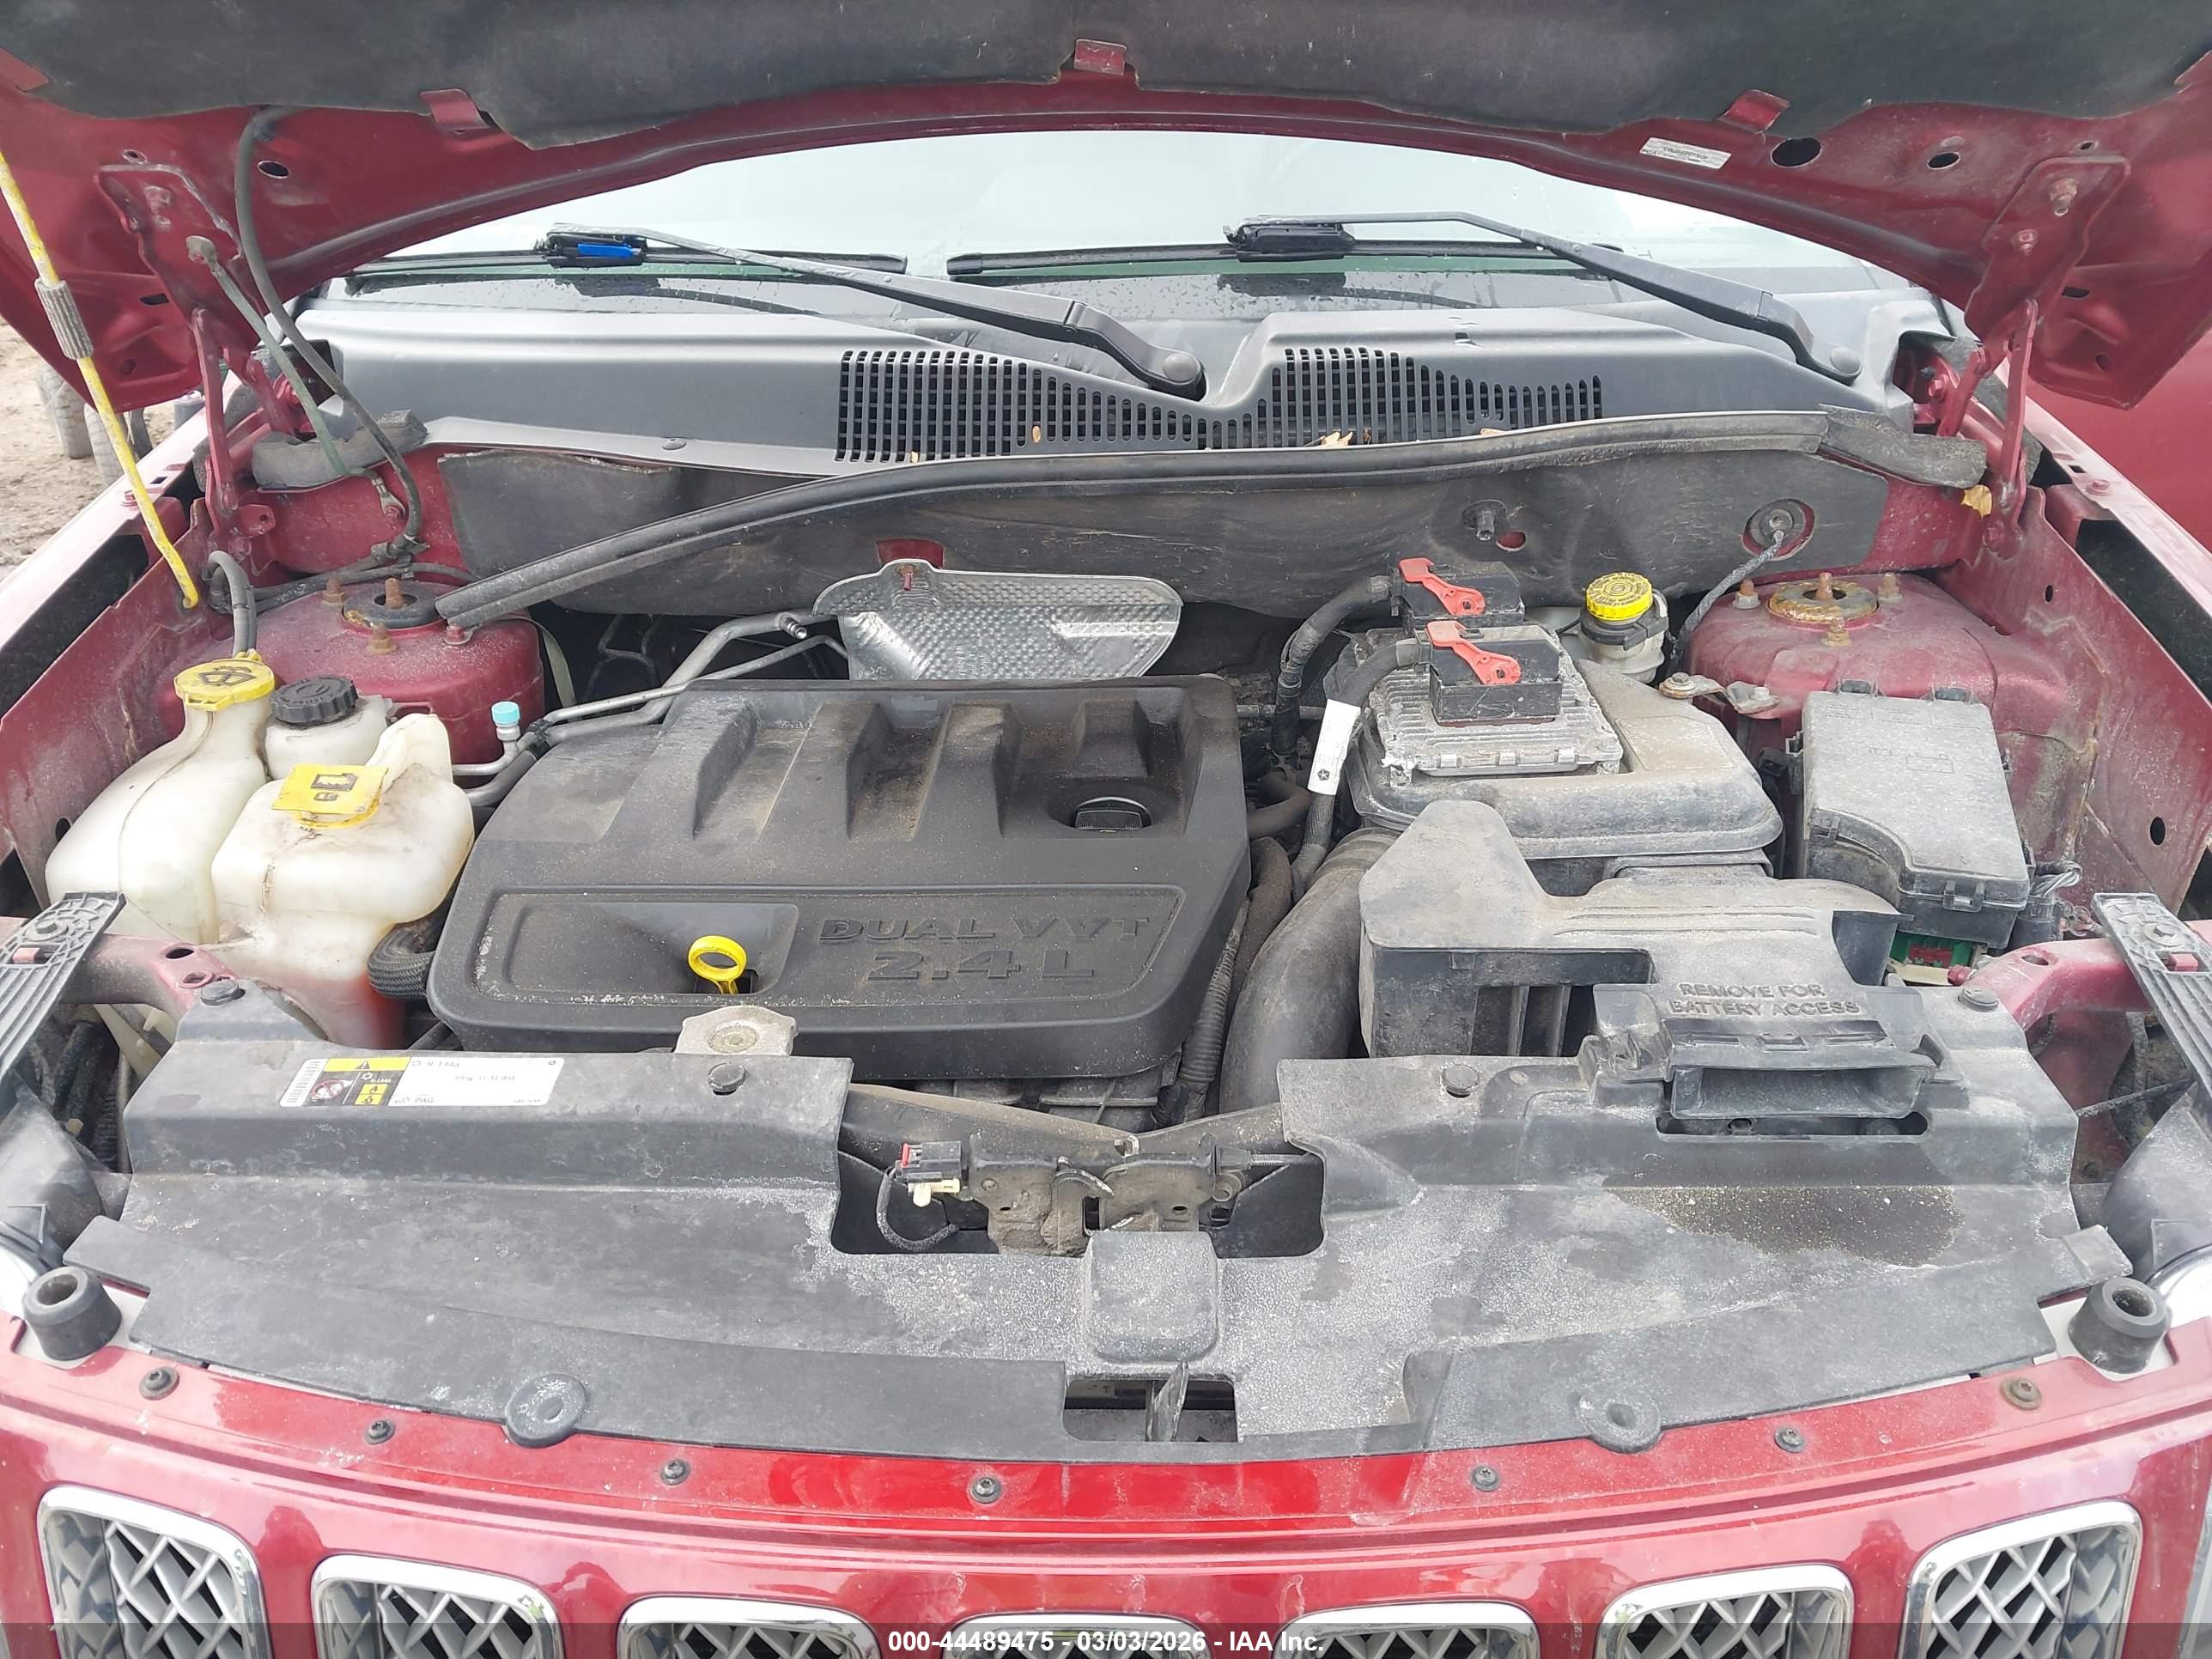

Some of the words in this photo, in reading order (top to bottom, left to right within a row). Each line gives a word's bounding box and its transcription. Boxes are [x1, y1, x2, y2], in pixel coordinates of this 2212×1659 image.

[819, 919, 995, 941] DUAL
[1011, 916, 1149, 940] VVT
[1678, 983, 1774, 998] REMOVE
[1777, 983, 1826, 998] FOR
[1669, 1000, 1762, 1016] BATTERY
[1772, 1000, 1861, 1016] ACCESS
